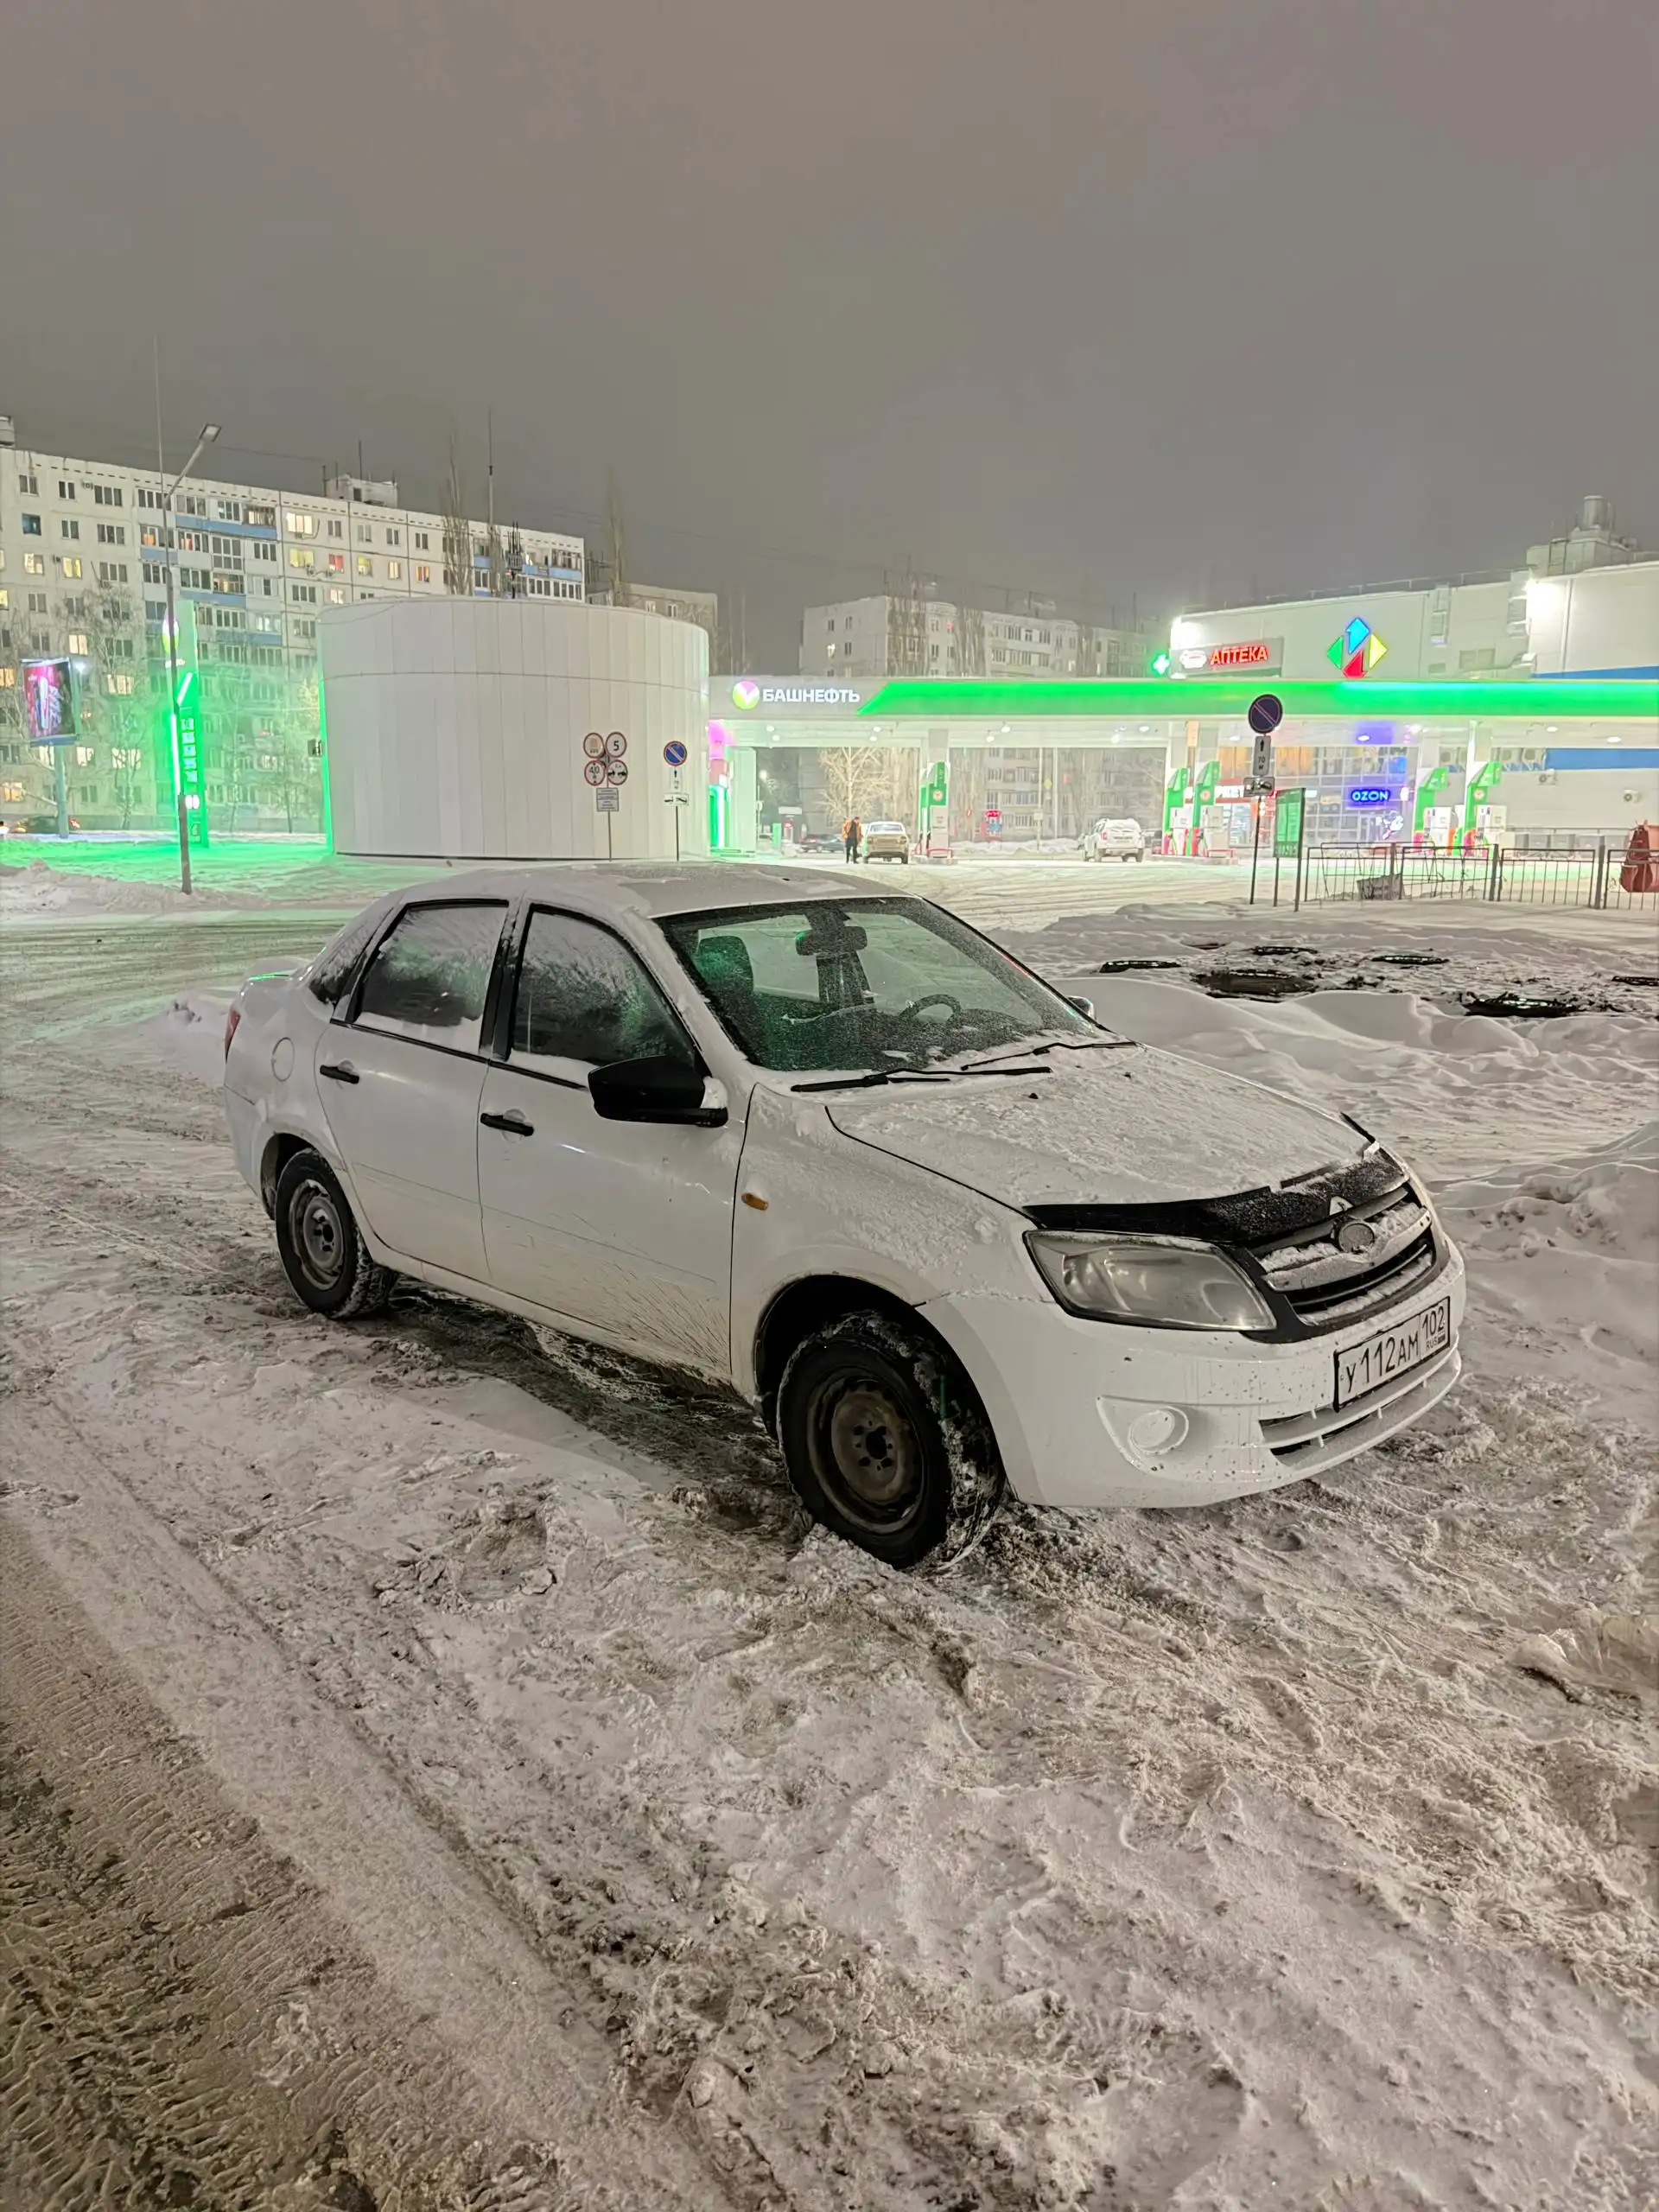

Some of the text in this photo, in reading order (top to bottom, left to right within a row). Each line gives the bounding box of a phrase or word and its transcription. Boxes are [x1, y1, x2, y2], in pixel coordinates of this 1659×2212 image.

[1210, 645, 1268, 664] АПТЕКА
[762, 689, 861, 703] БАШНЕФТЬ
[613, 741, 620, 752] 5
[1351, 790, 1389, 802] OZON
[1345, 1305, 1445, 1394] У112АМ 102
[1425, 1336, 1438, 1352] RUS
